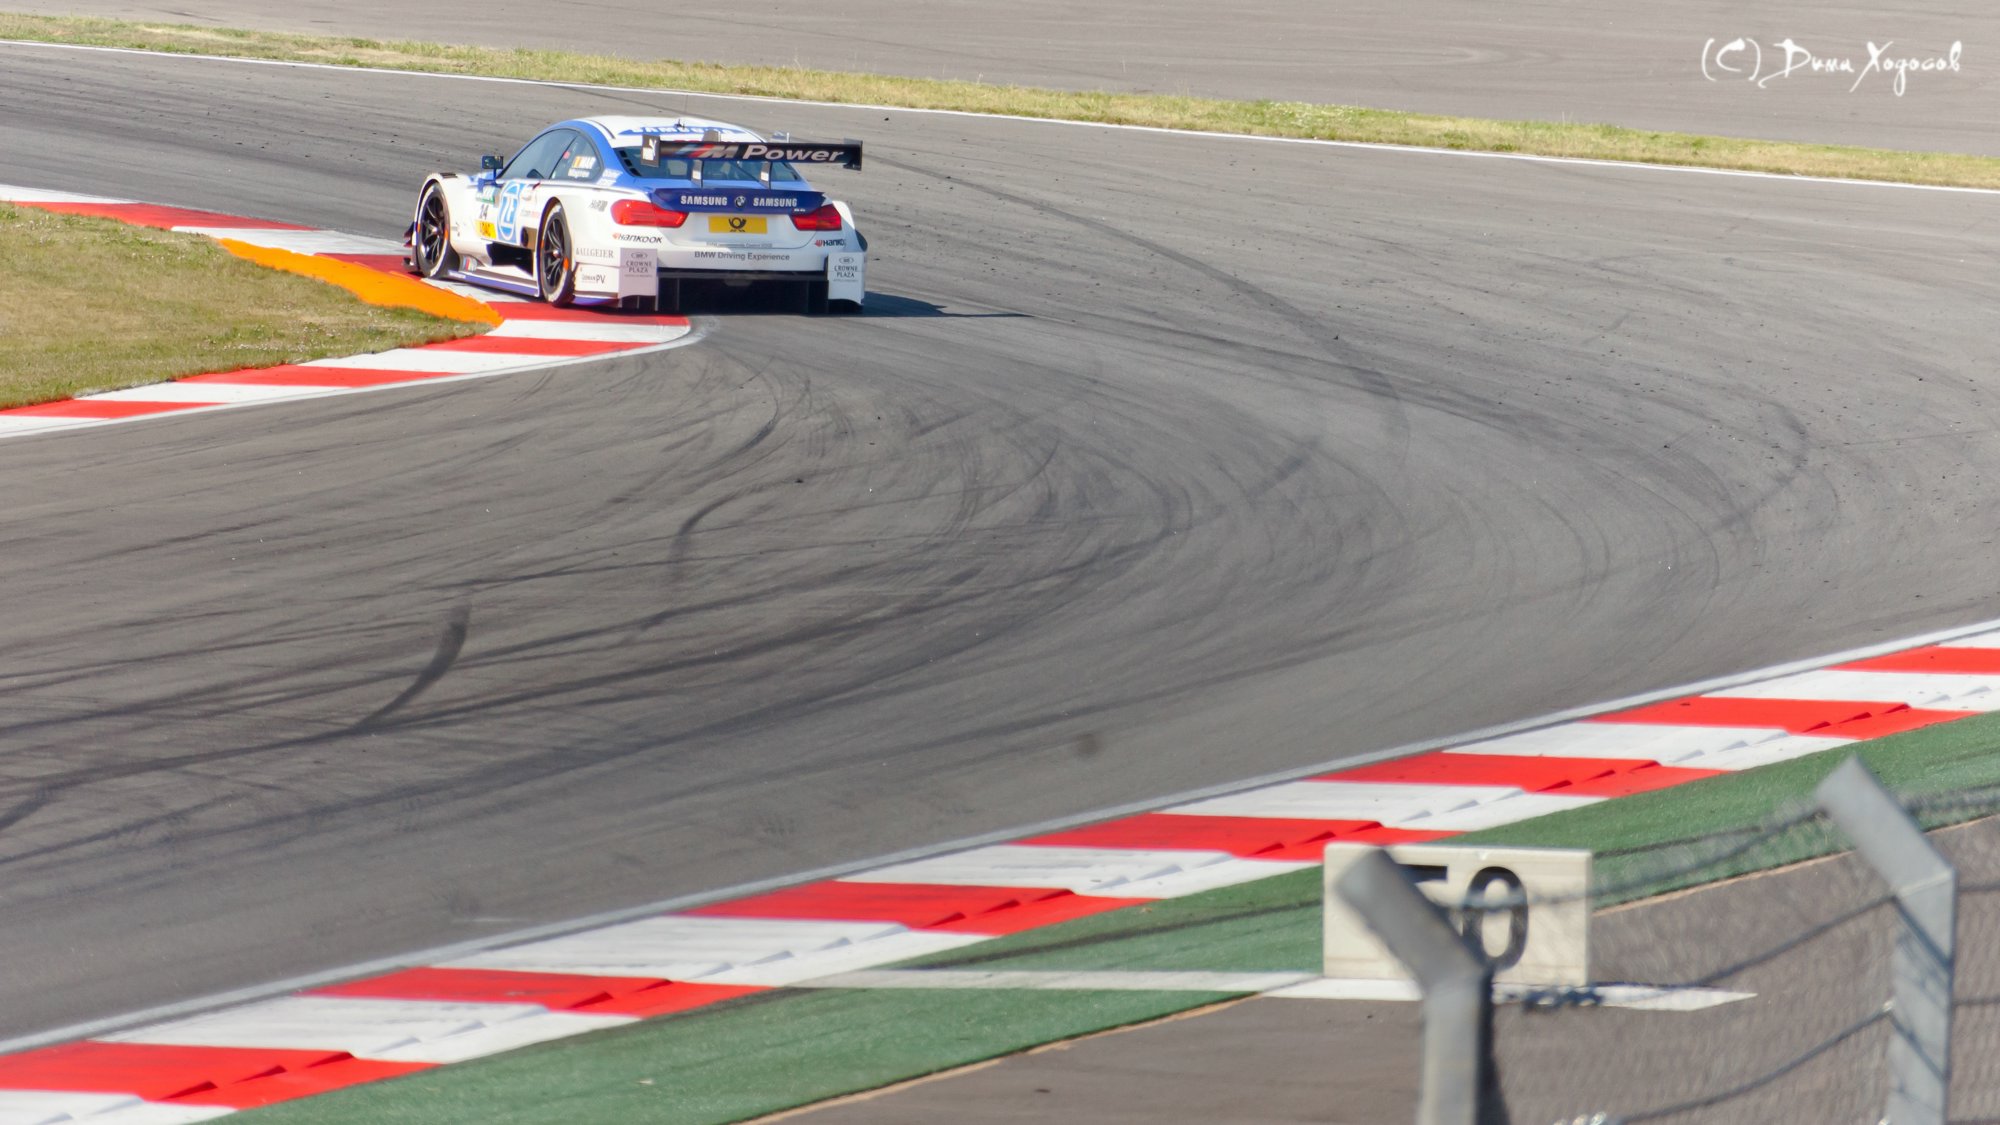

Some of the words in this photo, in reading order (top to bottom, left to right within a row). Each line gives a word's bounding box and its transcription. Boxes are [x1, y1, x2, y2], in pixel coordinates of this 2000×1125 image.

[742, 145, 844, 161] Power
[680, 195, 728, 206] SAMSUNG
[752, 197, 798, 207] SAMSUNG
[694, 251, 716, 259] BMW
[717, 251, 746, 261] Driving
[747, 252, 790, 261] Experience
[628, 266, 649, 274] PLAZA
[1398, 864, 1529, 971] 0
